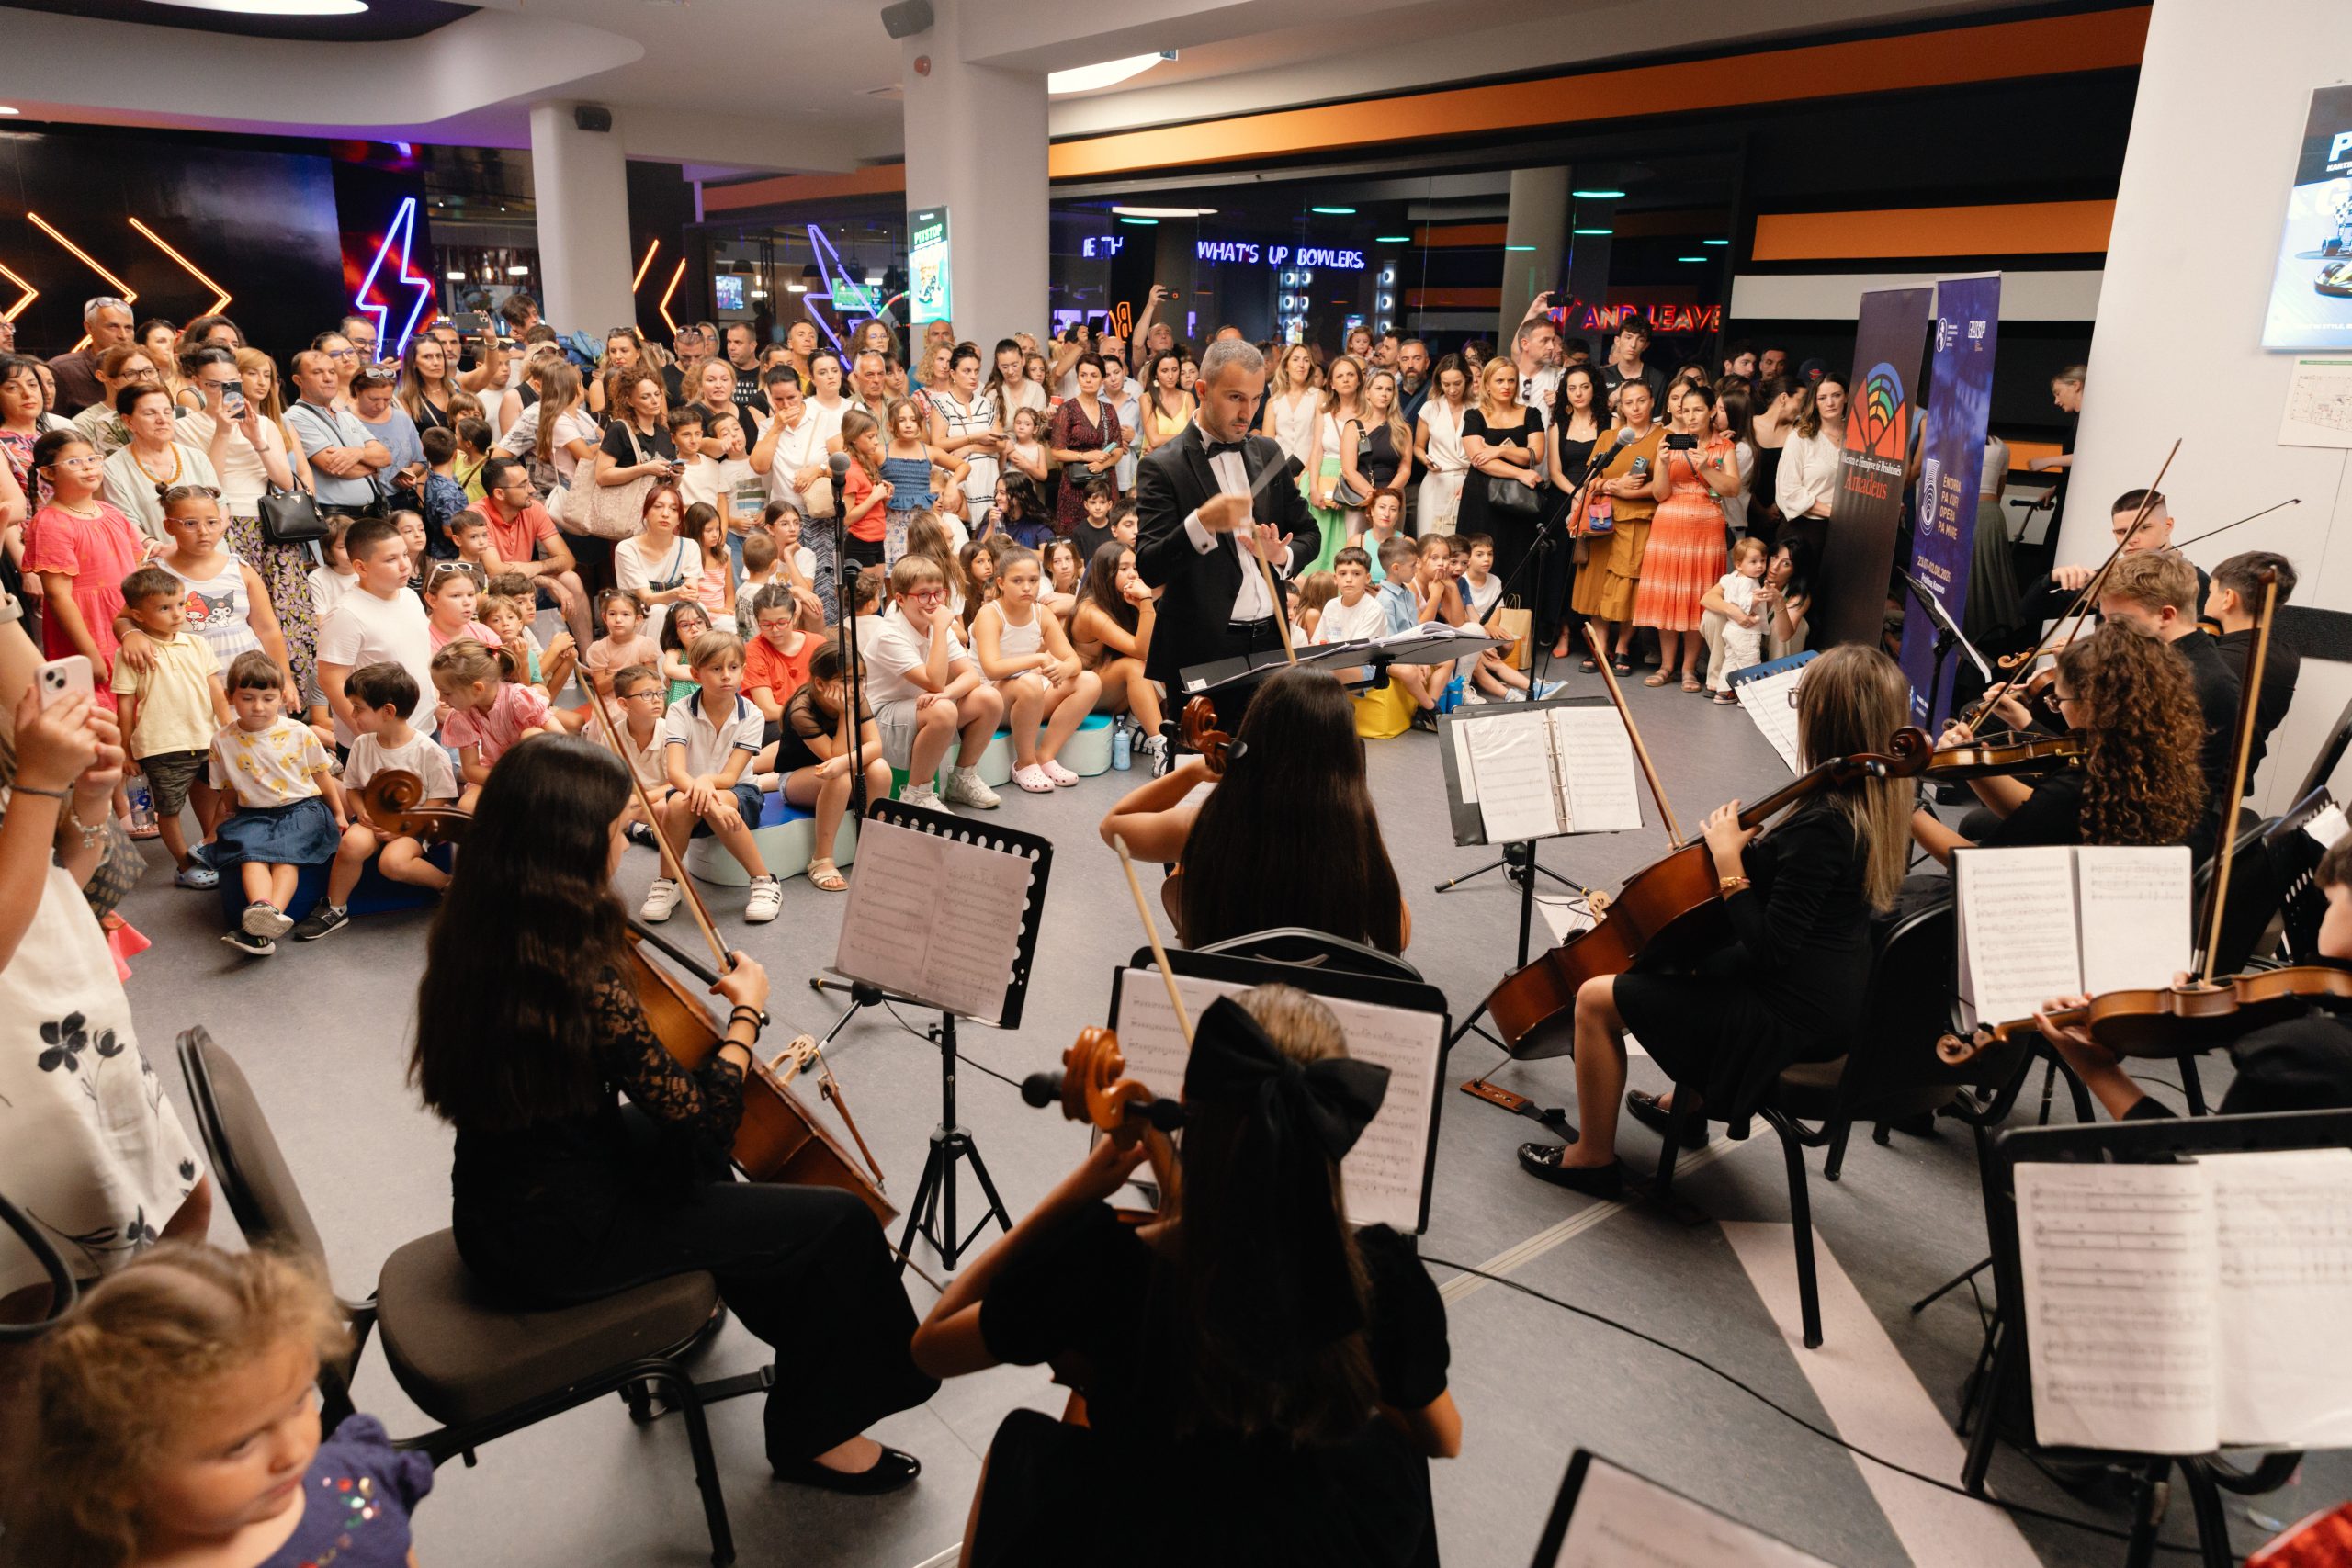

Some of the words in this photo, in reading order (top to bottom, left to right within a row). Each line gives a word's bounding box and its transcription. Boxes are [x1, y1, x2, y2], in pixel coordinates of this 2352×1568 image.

[914, 223, 943, 245] PITSTOP
[1197, 241, 1259, 264] WHAT'S
[1269, 245, 1288, 265] UP
[1297, 248, 1365, 269] BOWLERS,
[1648, 304, 1722, 333] LEAVE
[1844, 467, 1887, 500] Amadeus
[1941, 491, 1949, 504] PA
[1939, 505, 1956, 523] OPERA
[1938, 521, 1945, 534] PA
